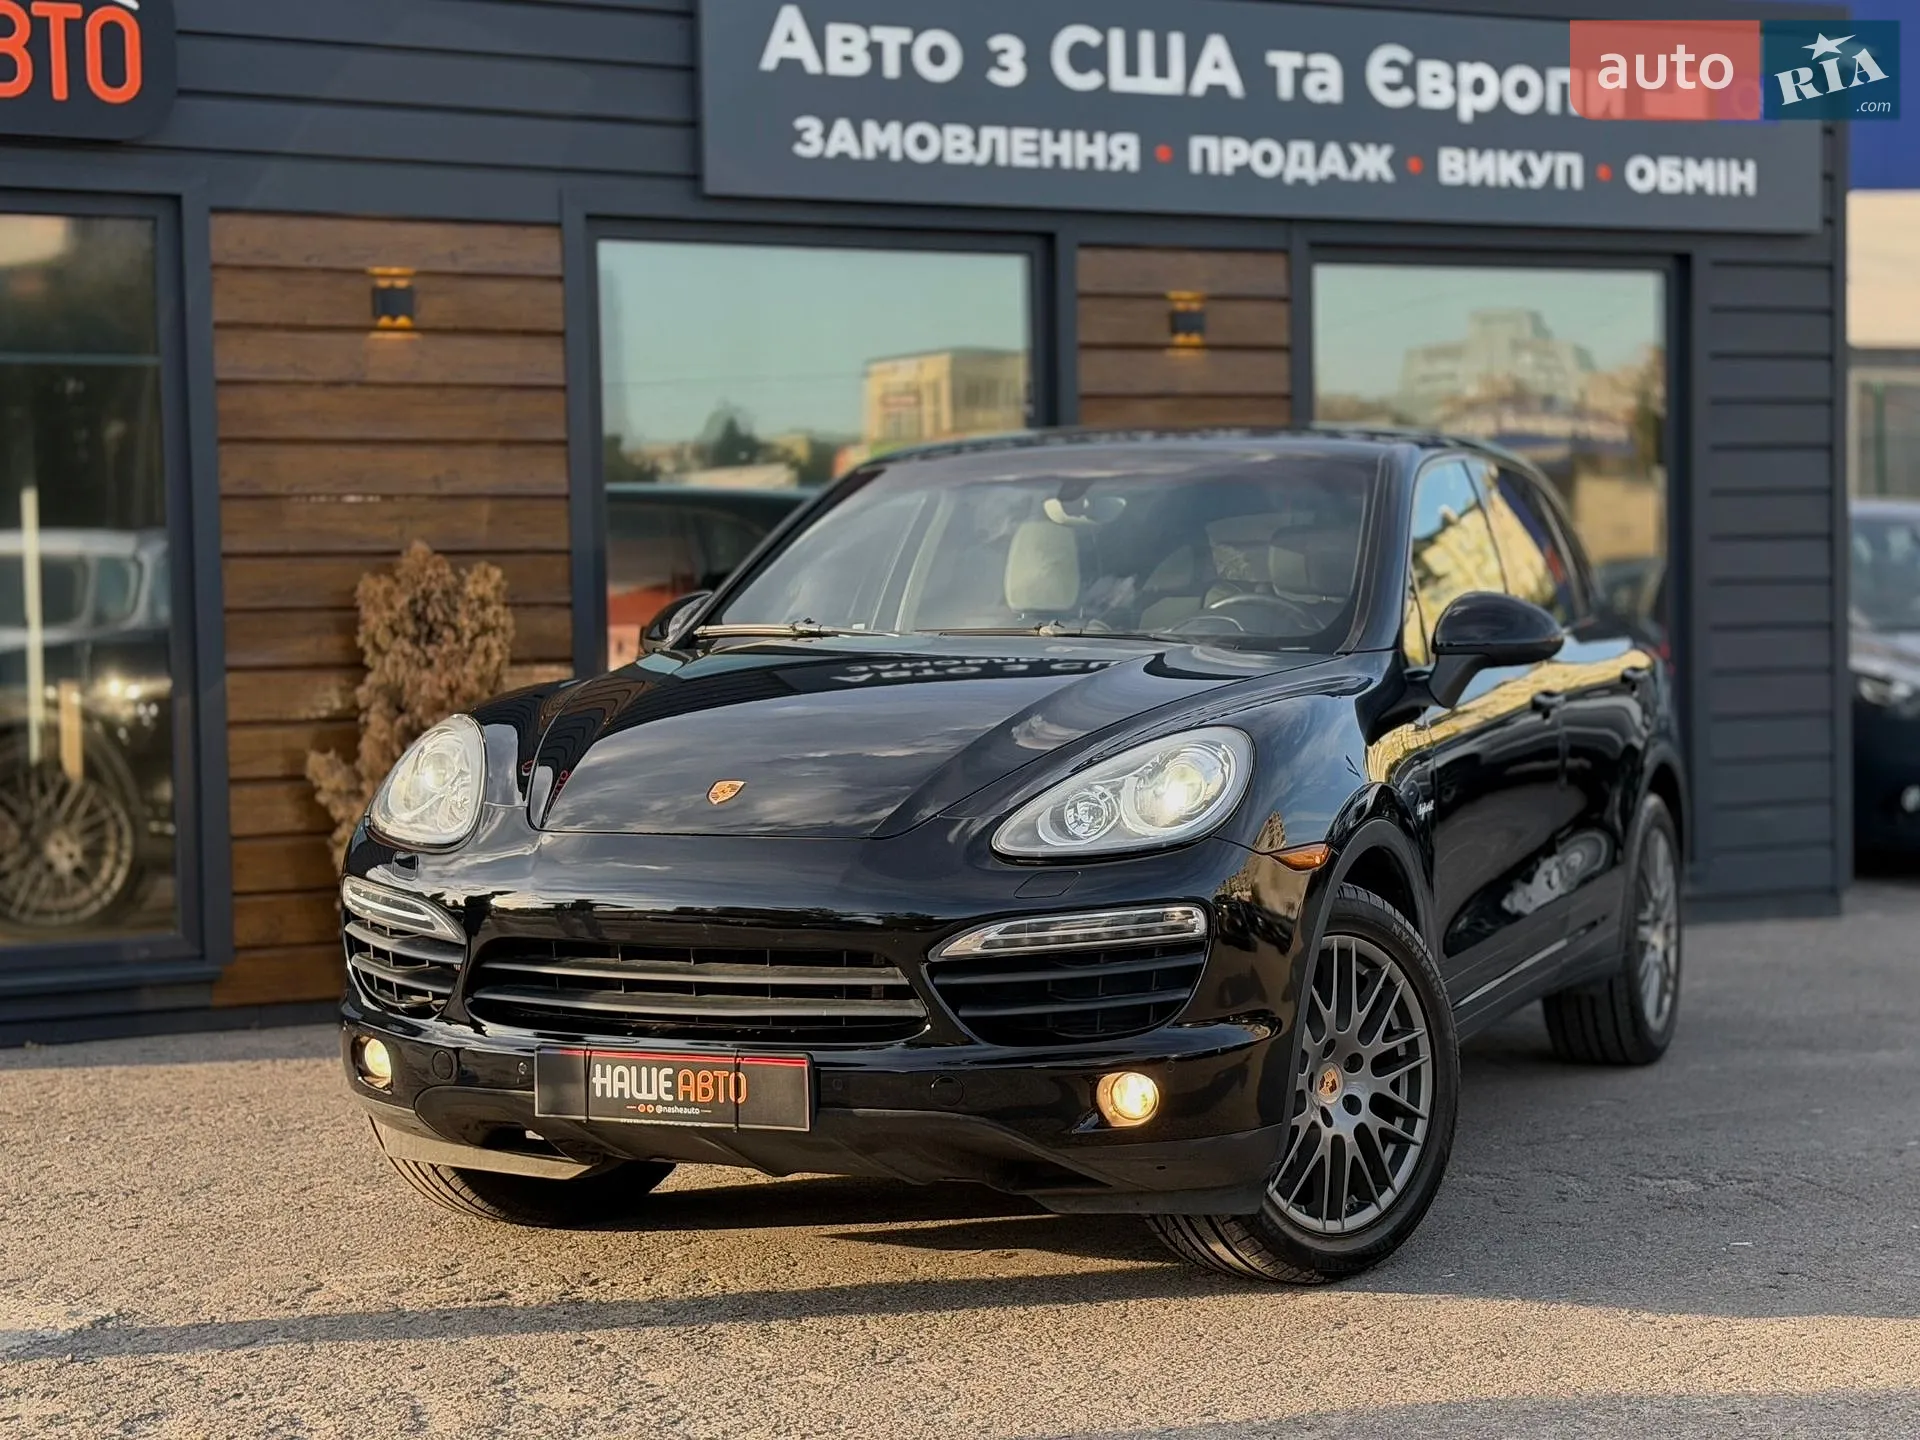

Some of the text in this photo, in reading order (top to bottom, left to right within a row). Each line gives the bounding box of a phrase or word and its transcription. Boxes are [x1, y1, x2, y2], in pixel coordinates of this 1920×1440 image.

[758, 4, 964, 84] Авто
[985, 33, 1028, 88] з
[1049, 23, 1246, 99] США
[1264, 50, 1344, 104] та
[792, 115, 1758, 196] ЗАМОВЛЕННЯ ПРОДАЖ ВИКУП ОБМІН
[592, 1063, 748, 1104] НАШЕ АВТО
[655, 1104, 701, 1115] @nasheauto
